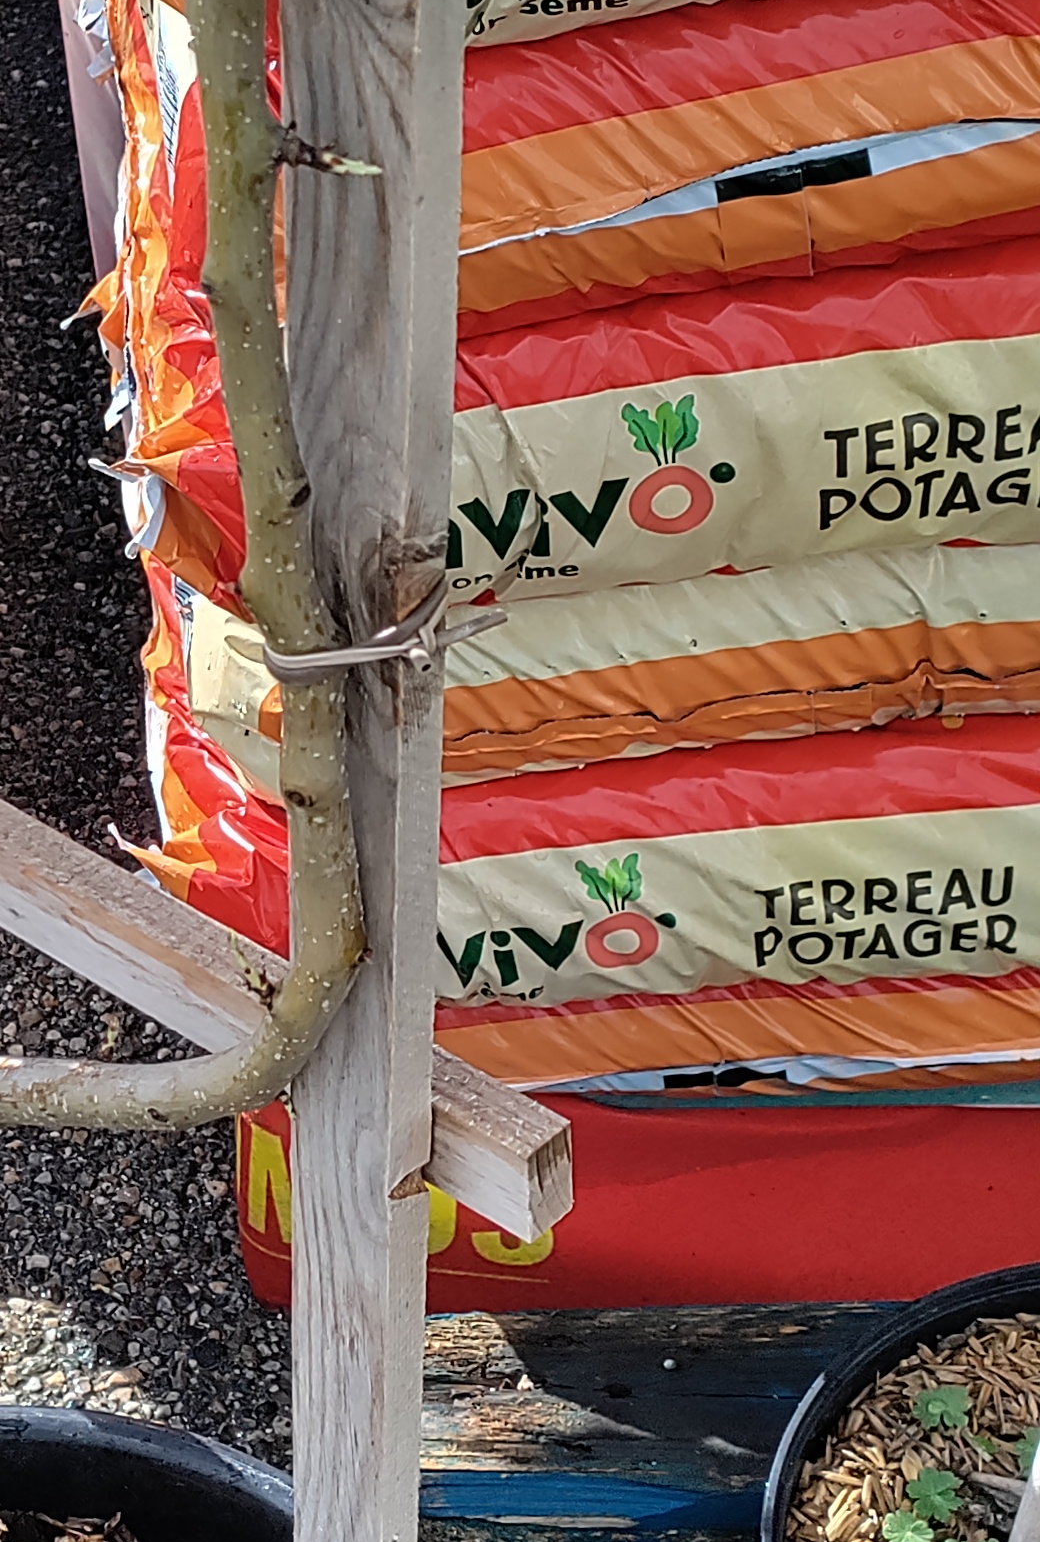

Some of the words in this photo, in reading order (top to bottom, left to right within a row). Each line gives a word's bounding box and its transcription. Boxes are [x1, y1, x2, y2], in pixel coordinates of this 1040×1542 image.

[824, 404, 1040, 478] TERRE
[819, 468, 1040, 531] POTAG
[754, 865, 1014, 926] TERREAU
[753, 914, 1018, 968] POTAGER
